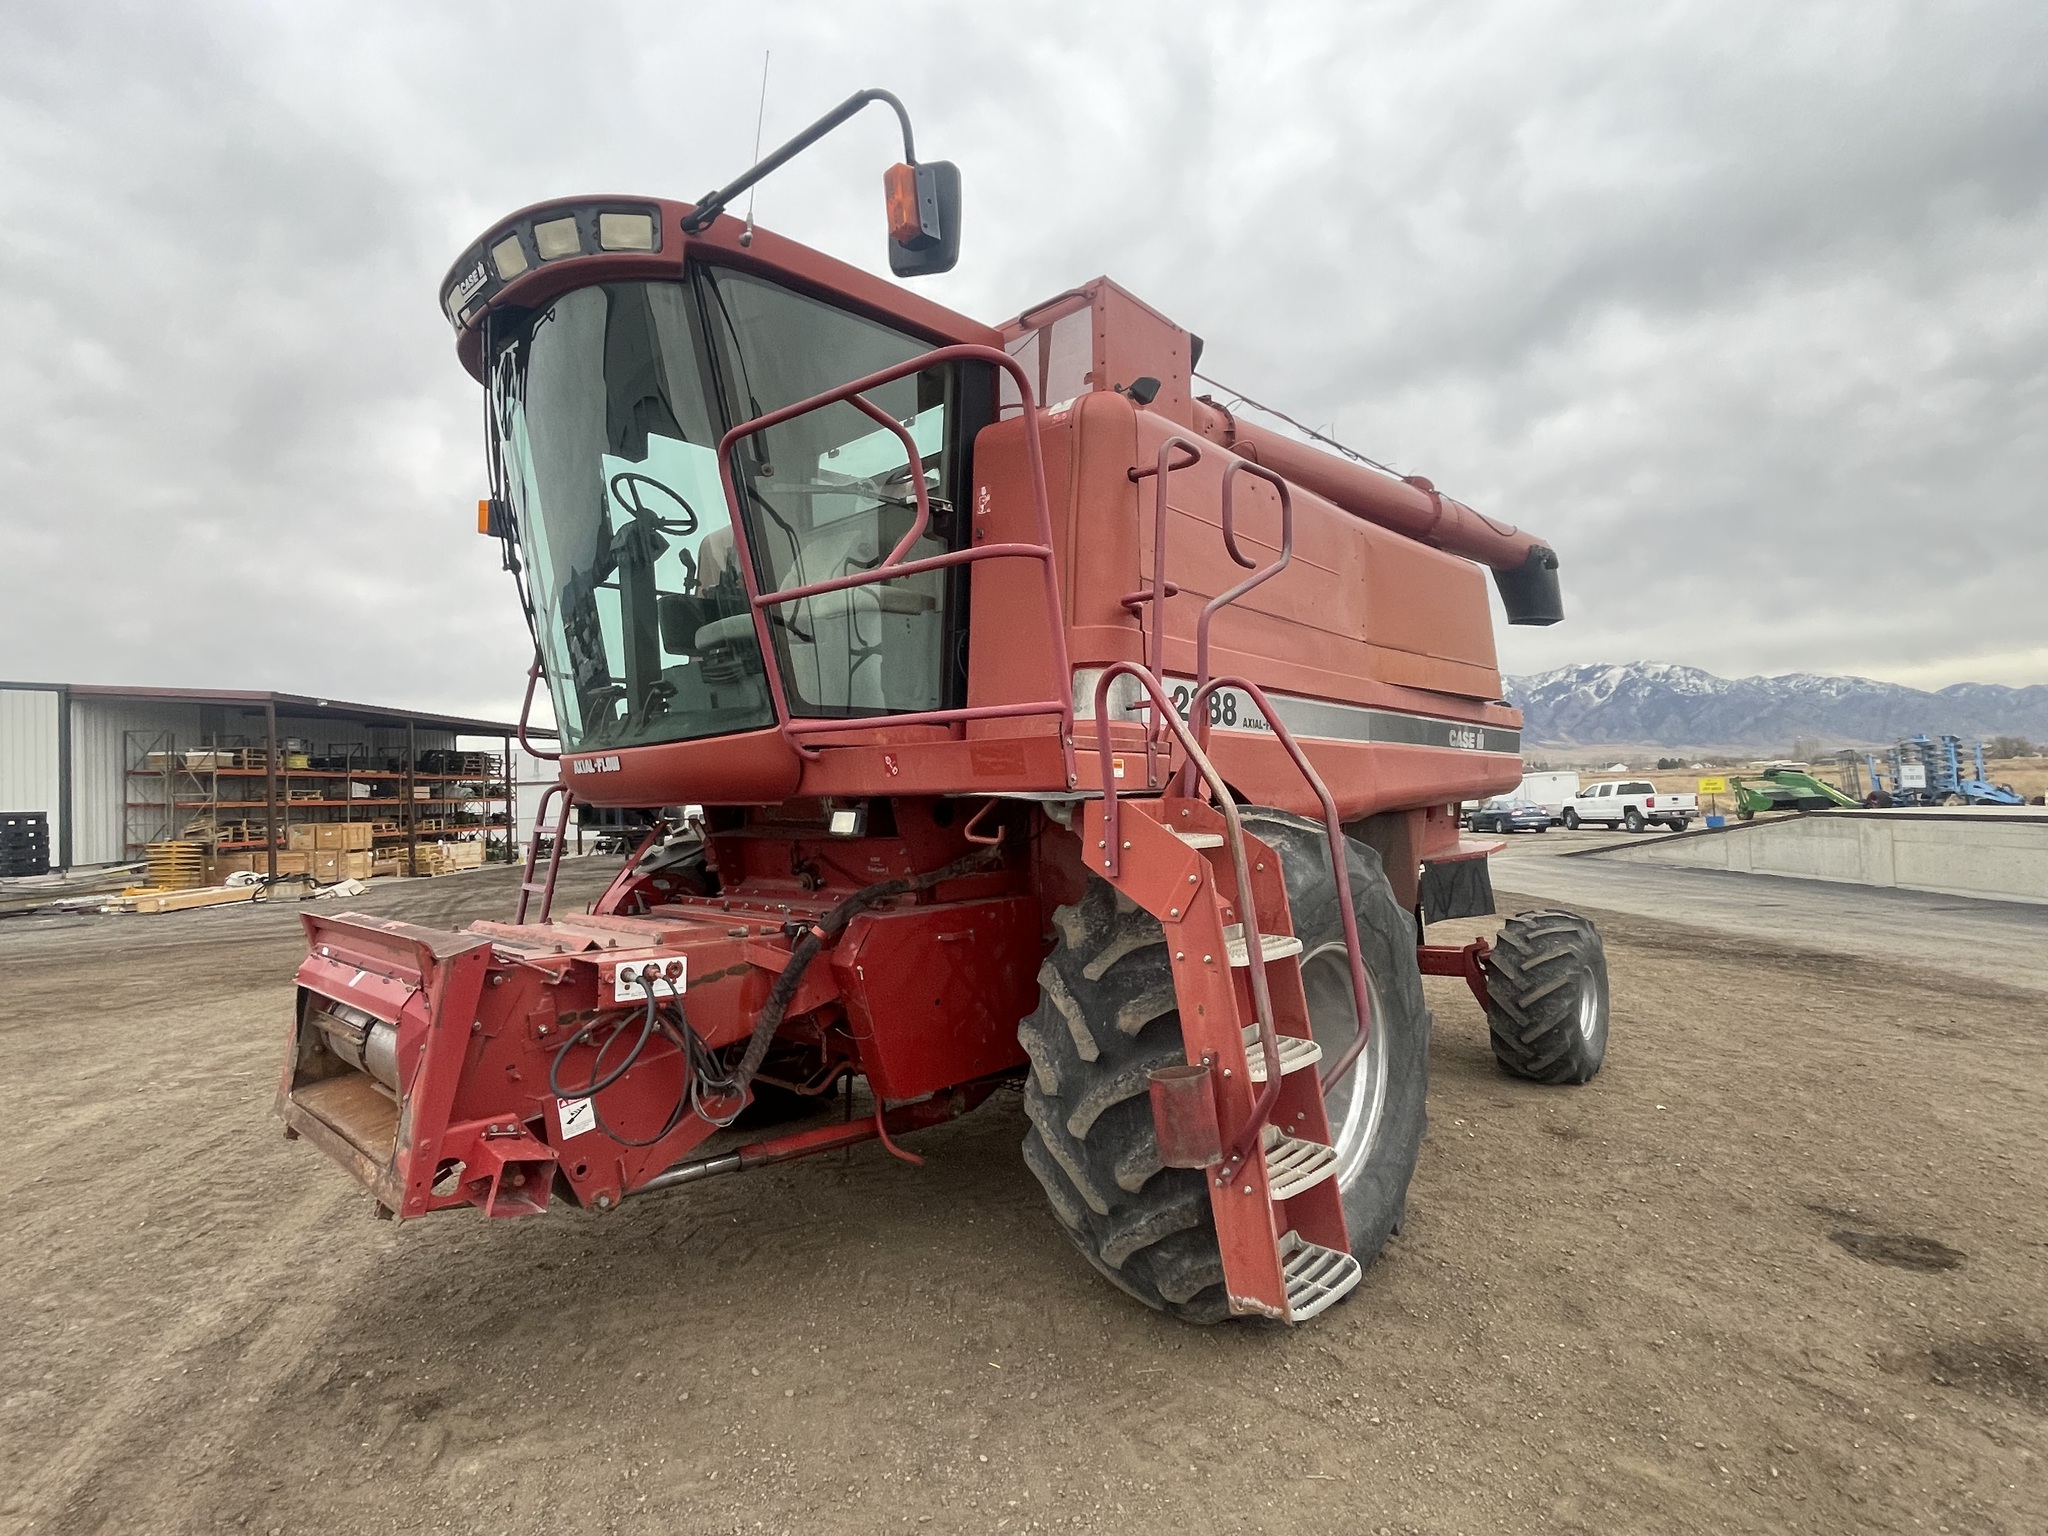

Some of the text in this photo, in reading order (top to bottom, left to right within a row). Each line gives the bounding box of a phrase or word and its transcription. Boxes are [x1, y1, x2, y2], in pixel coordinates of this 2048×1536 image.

[460, 269, 479, 295] CASE
[1174, 685, 1237, 726] 288
[1243, 717, 1273, 731] AXIAL-F
[1449, 730, 1476, 749] CASE
